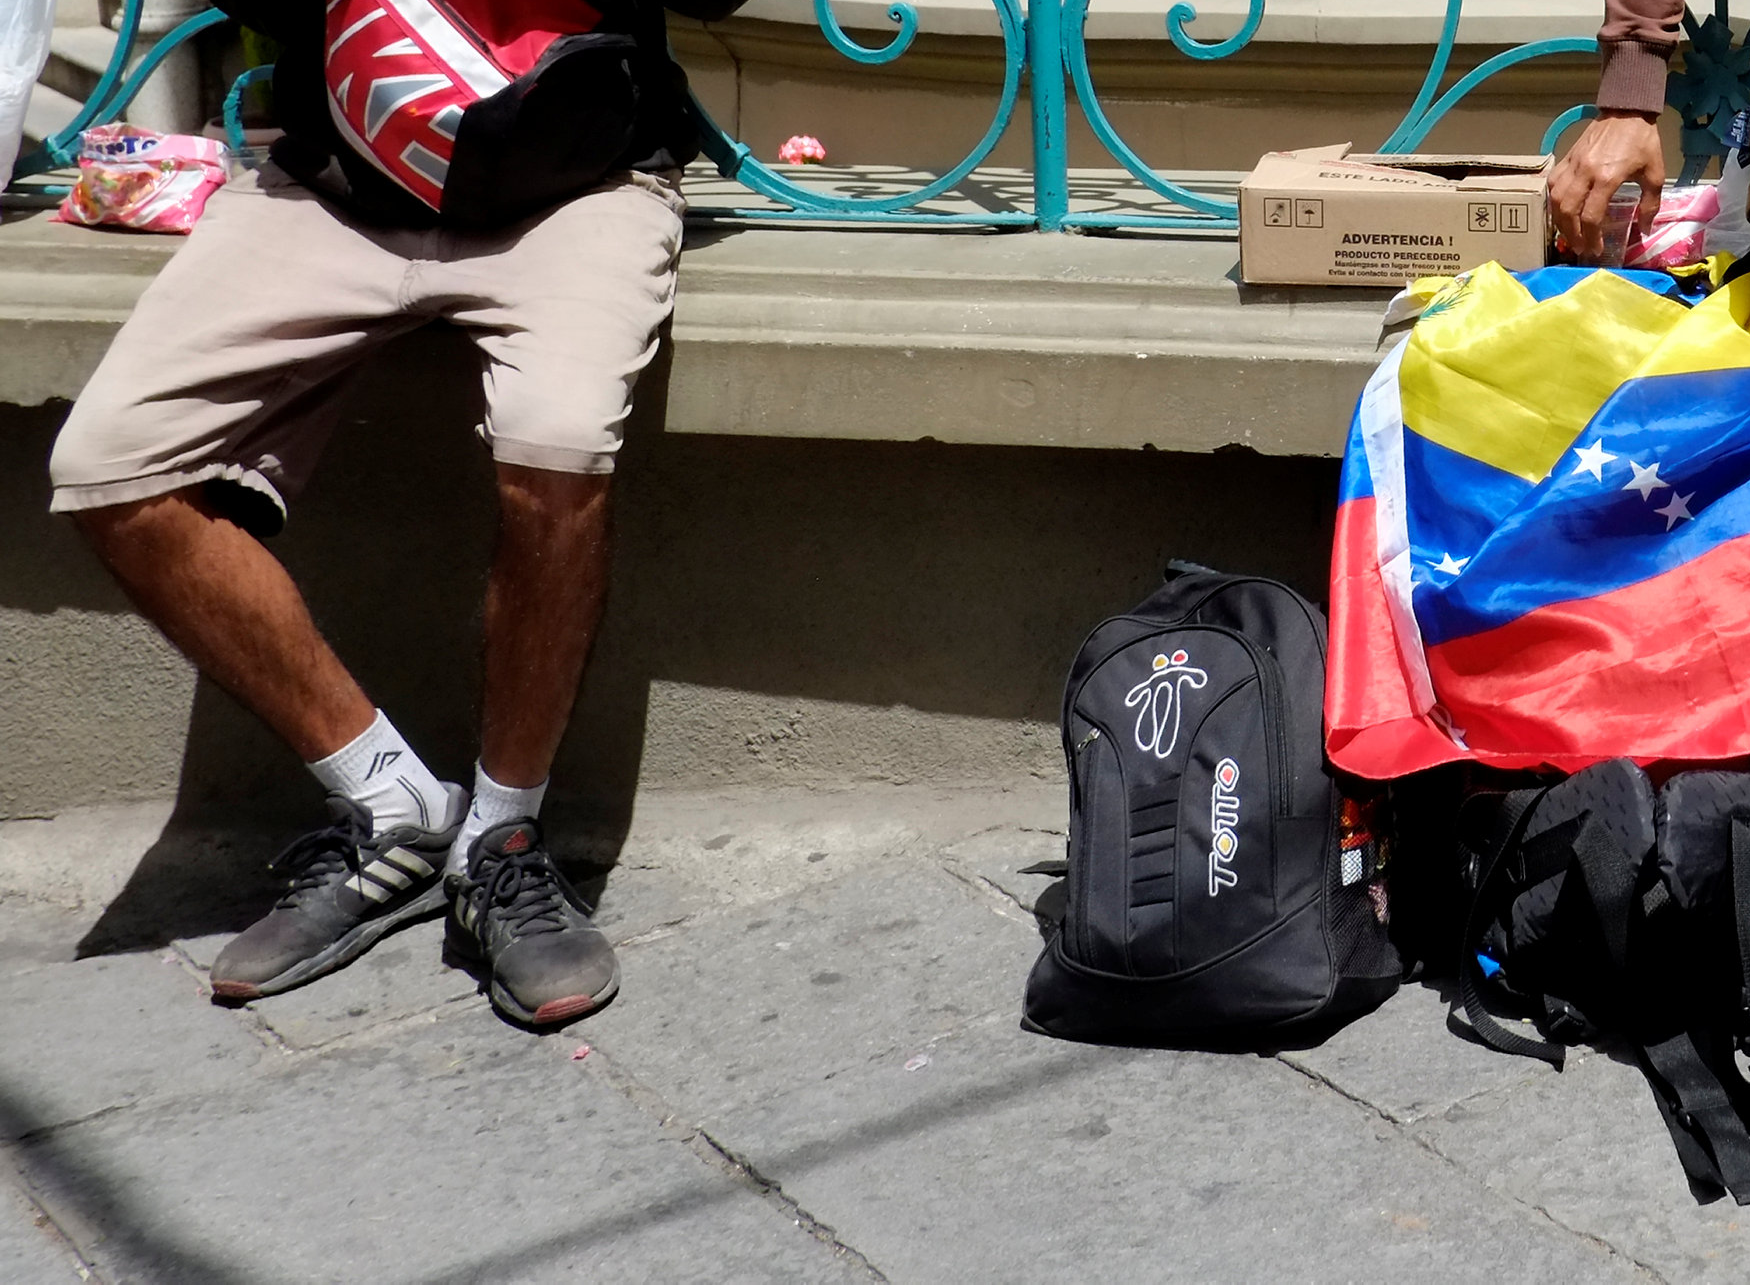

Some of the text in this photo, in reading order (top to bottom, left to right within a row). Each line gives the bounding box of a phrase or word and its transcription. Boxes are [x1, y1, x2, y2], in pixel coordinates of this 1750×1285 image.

[1318, 171, 1418, 185] ESTE LADO
[1342, 233, 1444, 246] ADVERTENCIA
[1334, 250, 1461, 262] PRODUCTO PERECEDERO
[1391, 261, 1410, 270] lugar
[1411, 262, 1435, 270] fresco
[1436, 263, 1442, 271] y
[1443, 263, 1461, 271] seco
[1405, 270, 1416, 278] los
[1208, 756, 1241, 897] TOTTO
